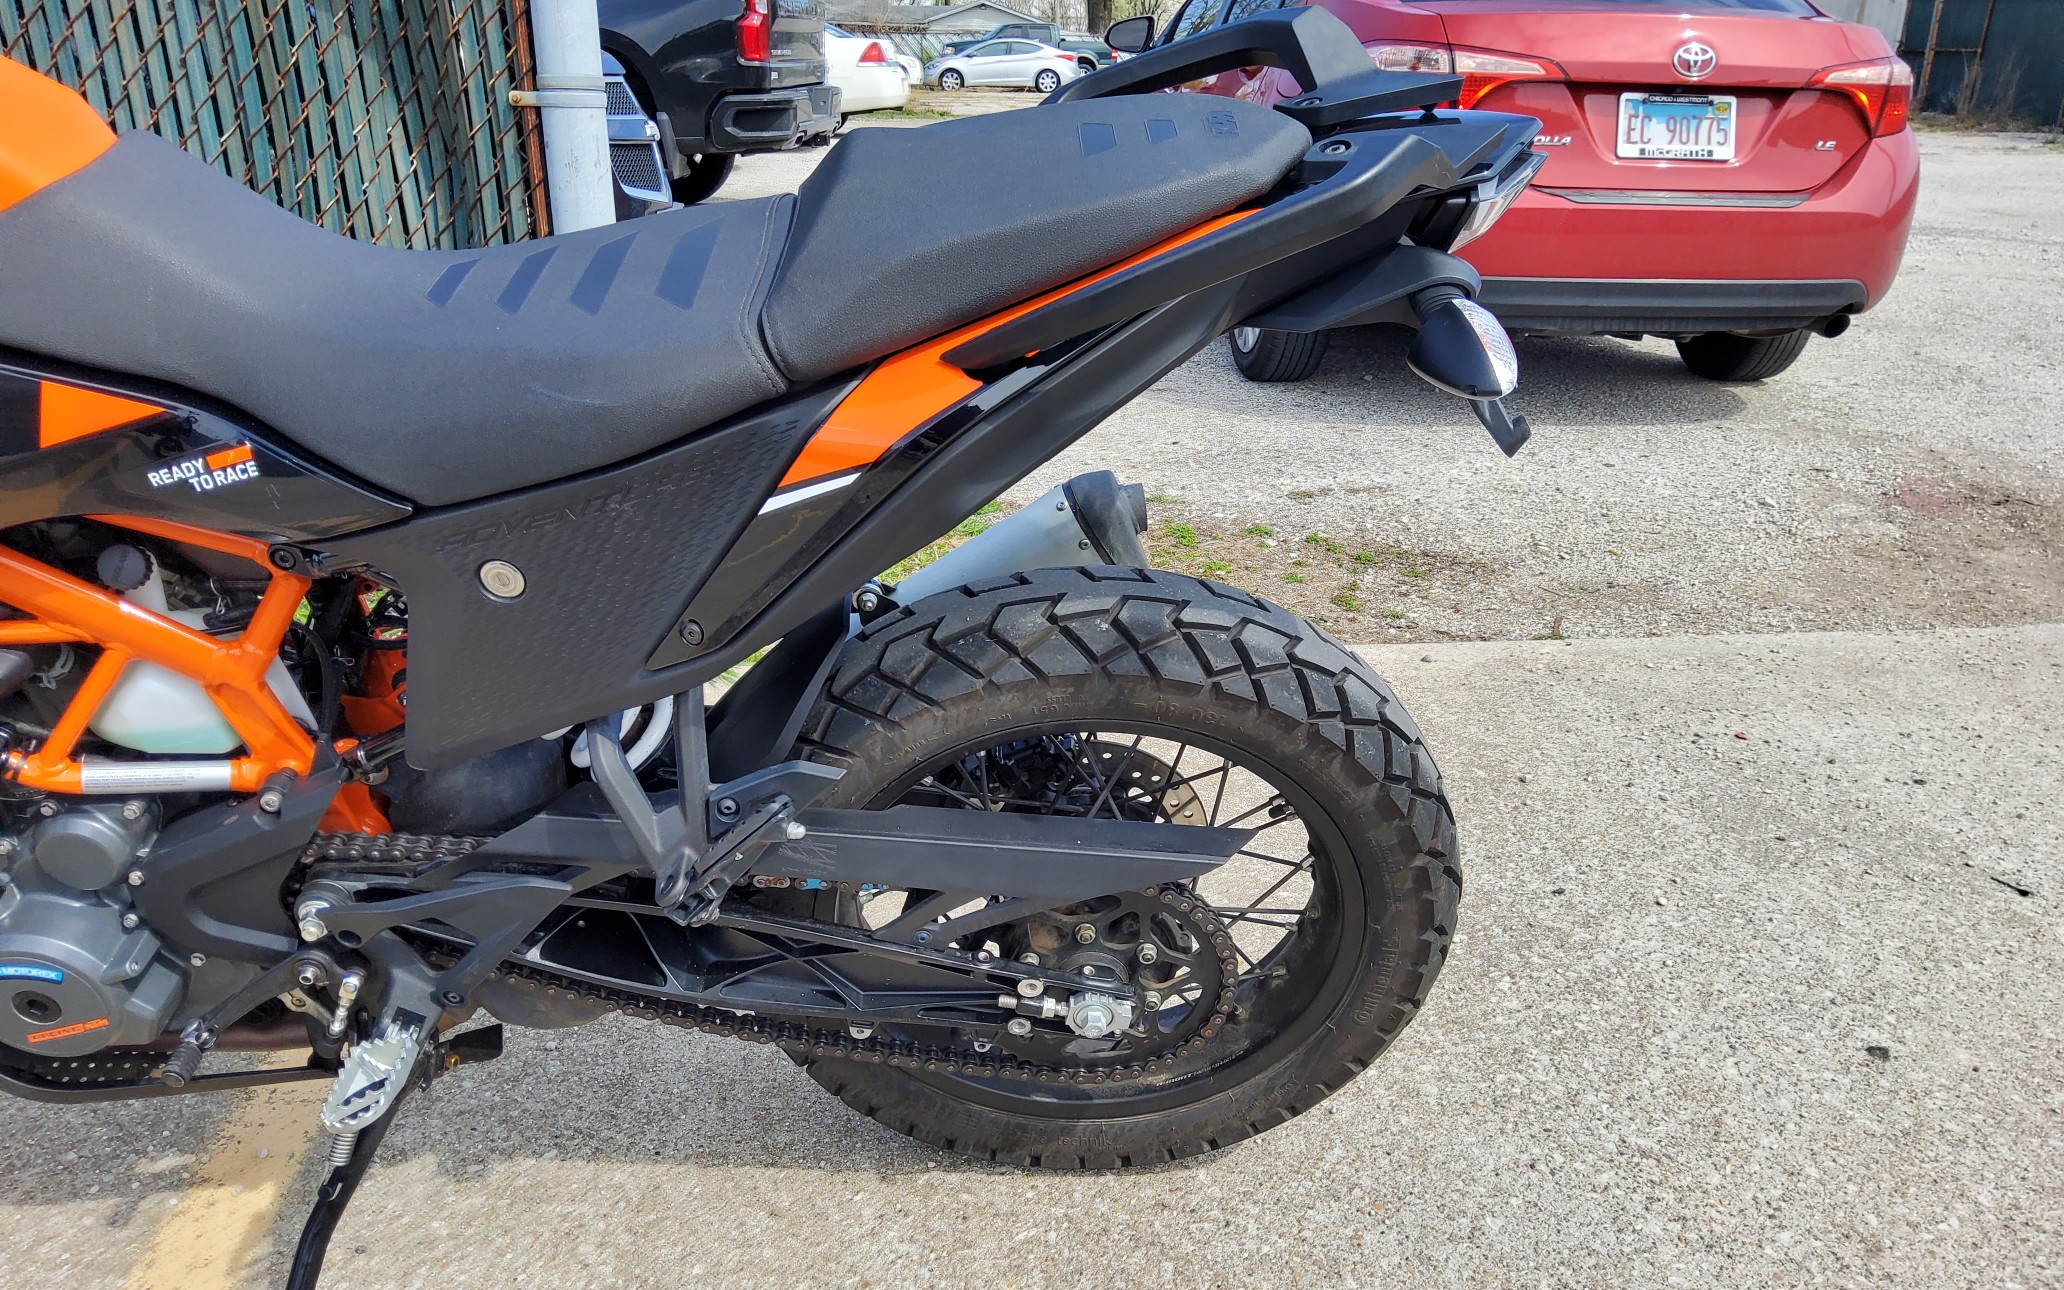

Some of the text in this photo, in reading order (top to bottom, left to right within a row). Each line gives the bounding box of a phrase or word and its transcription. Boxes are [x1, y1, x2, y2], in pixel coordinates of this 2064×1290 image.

[1626, 114, 1728, 146] EC 90775
[1815, 140, 1837, 151] LE
[147, 458, 205, 487] READY
[188, 461, 259, 492] TO RACE
